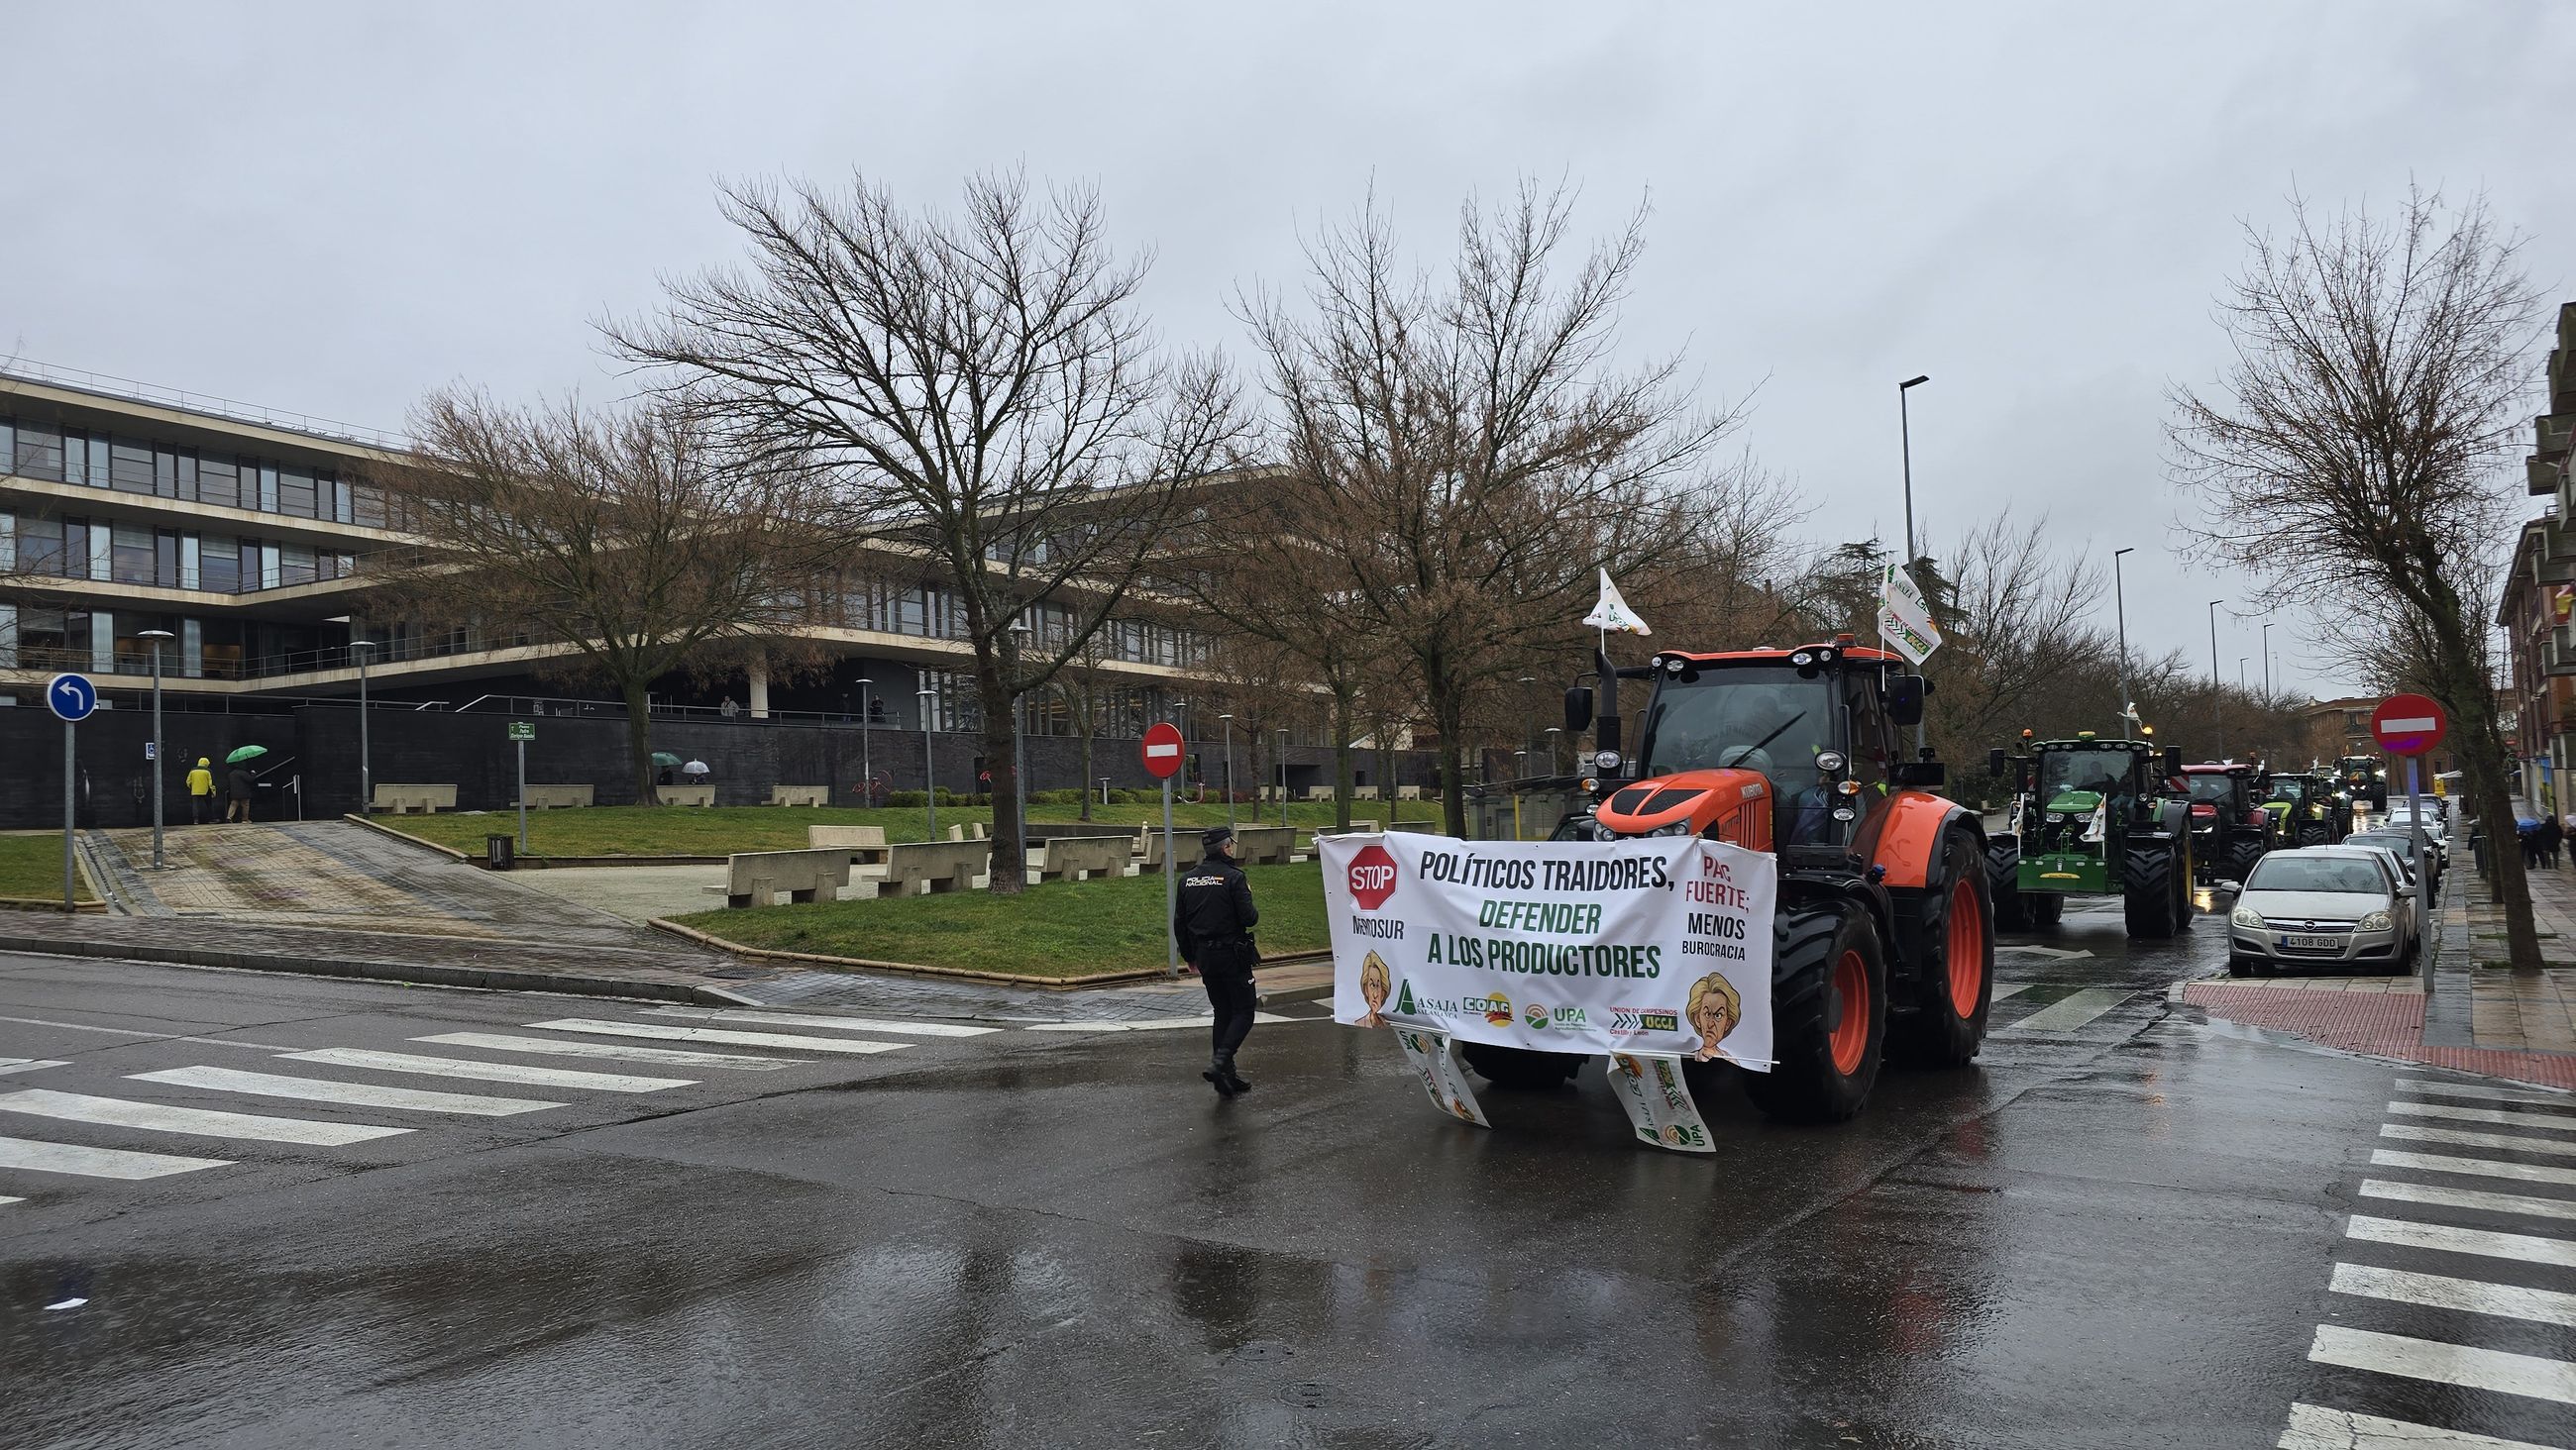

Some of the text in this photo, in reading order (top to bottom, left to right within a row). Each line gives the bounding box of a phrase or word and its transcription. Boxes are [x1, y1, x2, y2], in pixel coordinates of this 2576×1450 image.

[1350, 865, 1395, 890] STOP
[1420, 851, 1675, 891] POLÍTICOS TRAIDORES,
[1703, 855, 1732, 883] PAC
[1685, 880, 1750, 913] FUERTE;
[1478, 899, 1602, 934] DEFENDER
[1687, 912, 1746, 940] MENOS
[1682, 940, 1746, 962] BUROCRACIA
[2290, 937, 2336, 948] 4108 GDD
[1427, 933, 1662, 979] A LOS PRODUCTORES
[1463, 996, 1510, 1013] COAG
[1554, 1007, 1586, 1022] UPA
[1646, 1015, 1675, 1030] UCCL
[1689, 1124, 1706, 1147] UPA
